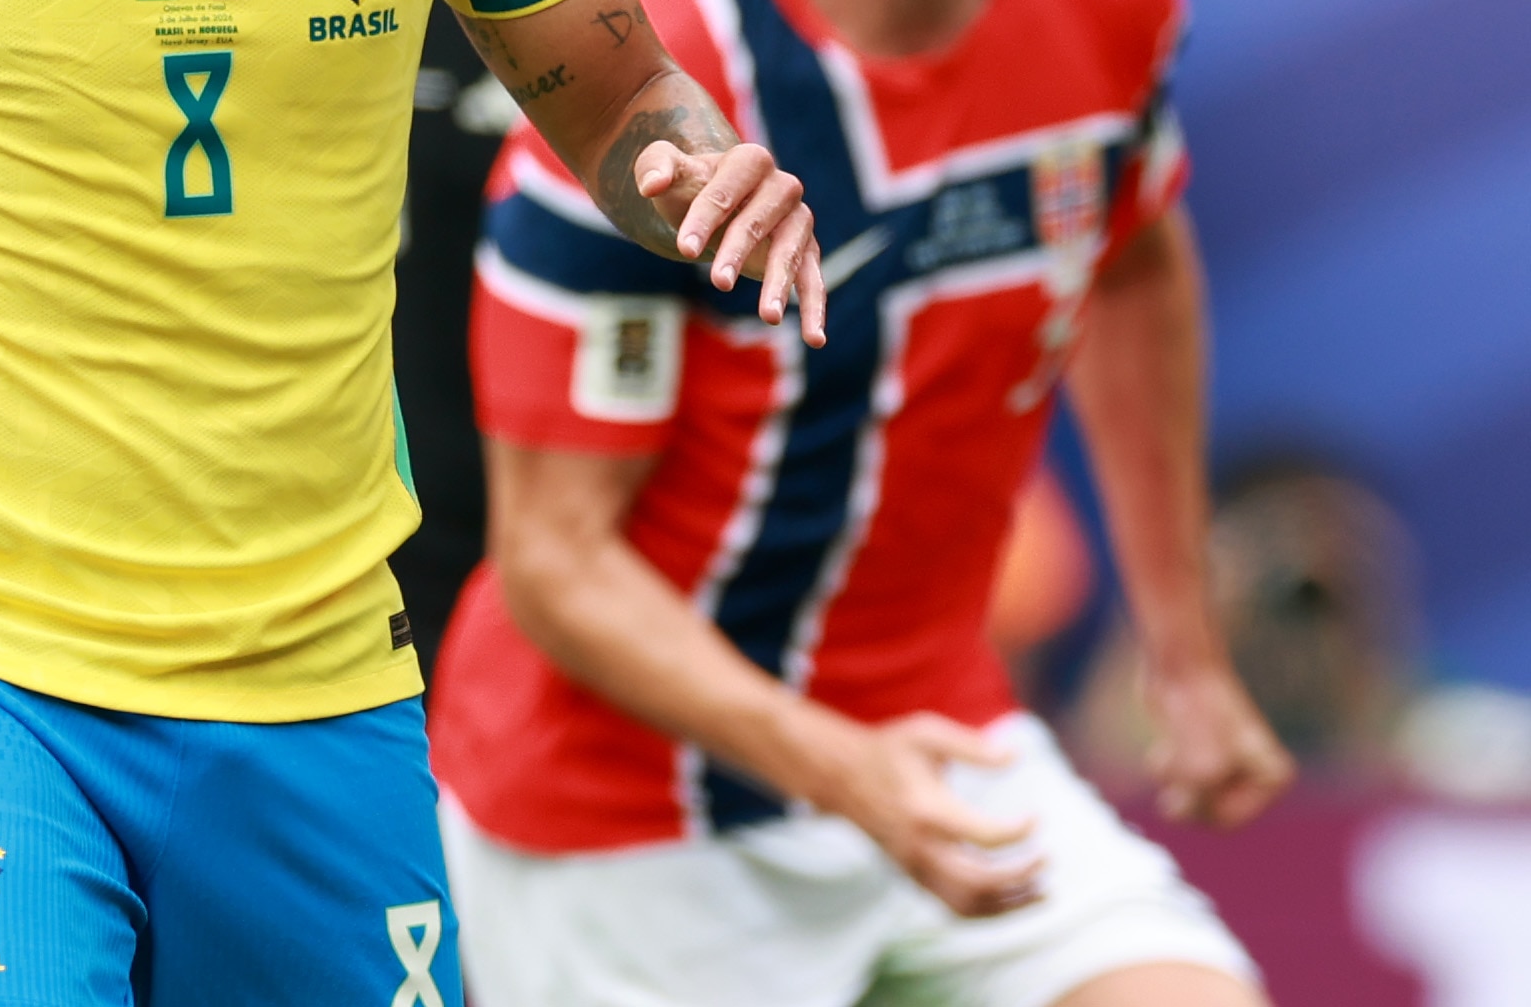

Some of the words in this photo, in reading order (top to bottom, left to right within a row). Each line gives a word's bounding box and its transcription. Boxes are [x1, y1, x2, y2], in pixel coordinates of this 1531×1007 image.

[155, 26, 184, 36] BRASIL
[199, 25, 238, 35] NORUEGA
[309, 8, 400, 43] BRASIL
[216, 36, 234, 44] EUA
[163, 51, 234, 218] 8
